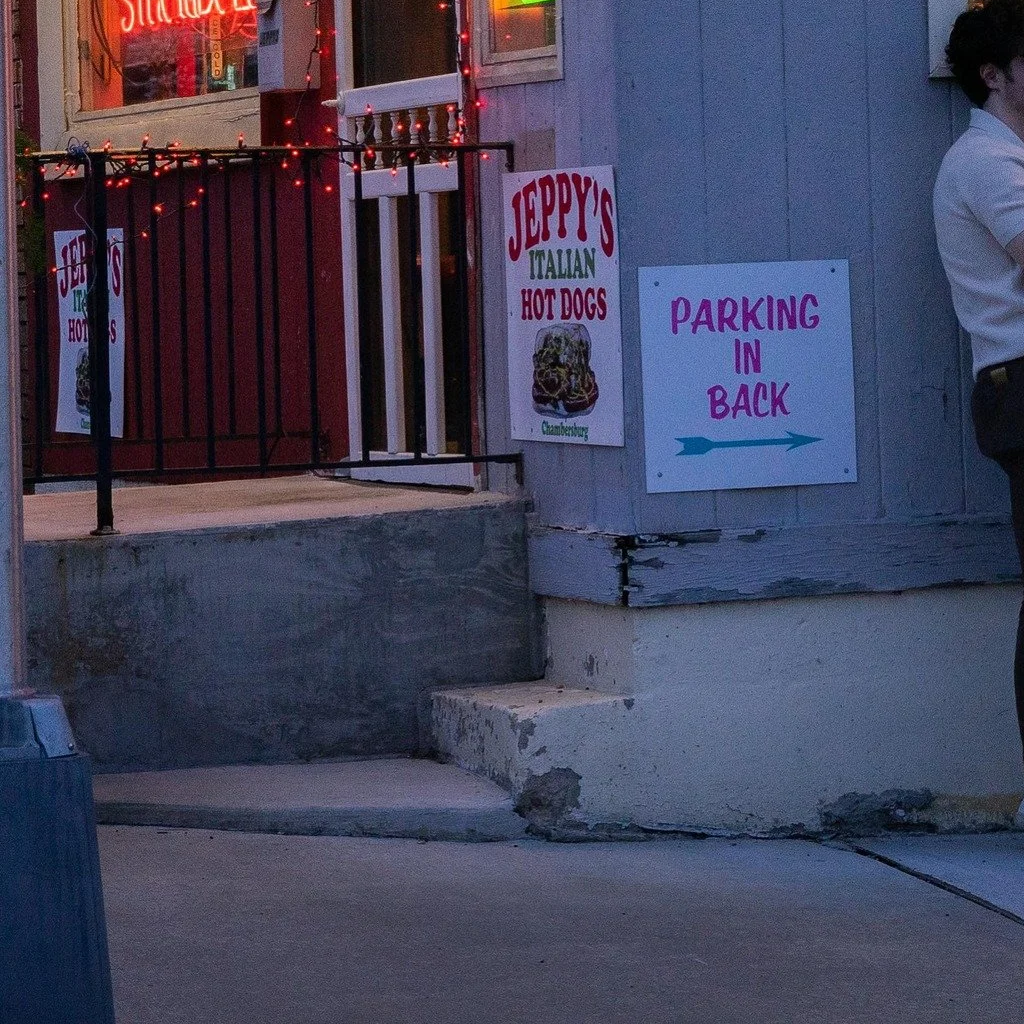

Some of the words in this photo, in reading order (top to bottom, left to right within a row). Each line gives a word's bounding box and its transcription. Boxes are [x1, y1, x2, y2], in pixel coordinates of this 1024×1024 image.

[508, 172, 615, 262] JEPPY'S
[528, 247, 597, 280] ITALIAN
[520, 288, 556, 321] HOT
[560, 287, 608, 321] DOGS
[670, 293, 820, 335] PARKING
[67, 318, 88, 343] HOT
[734, 338, 762, 375] IN
[706, 381, 791, 420] BACK
